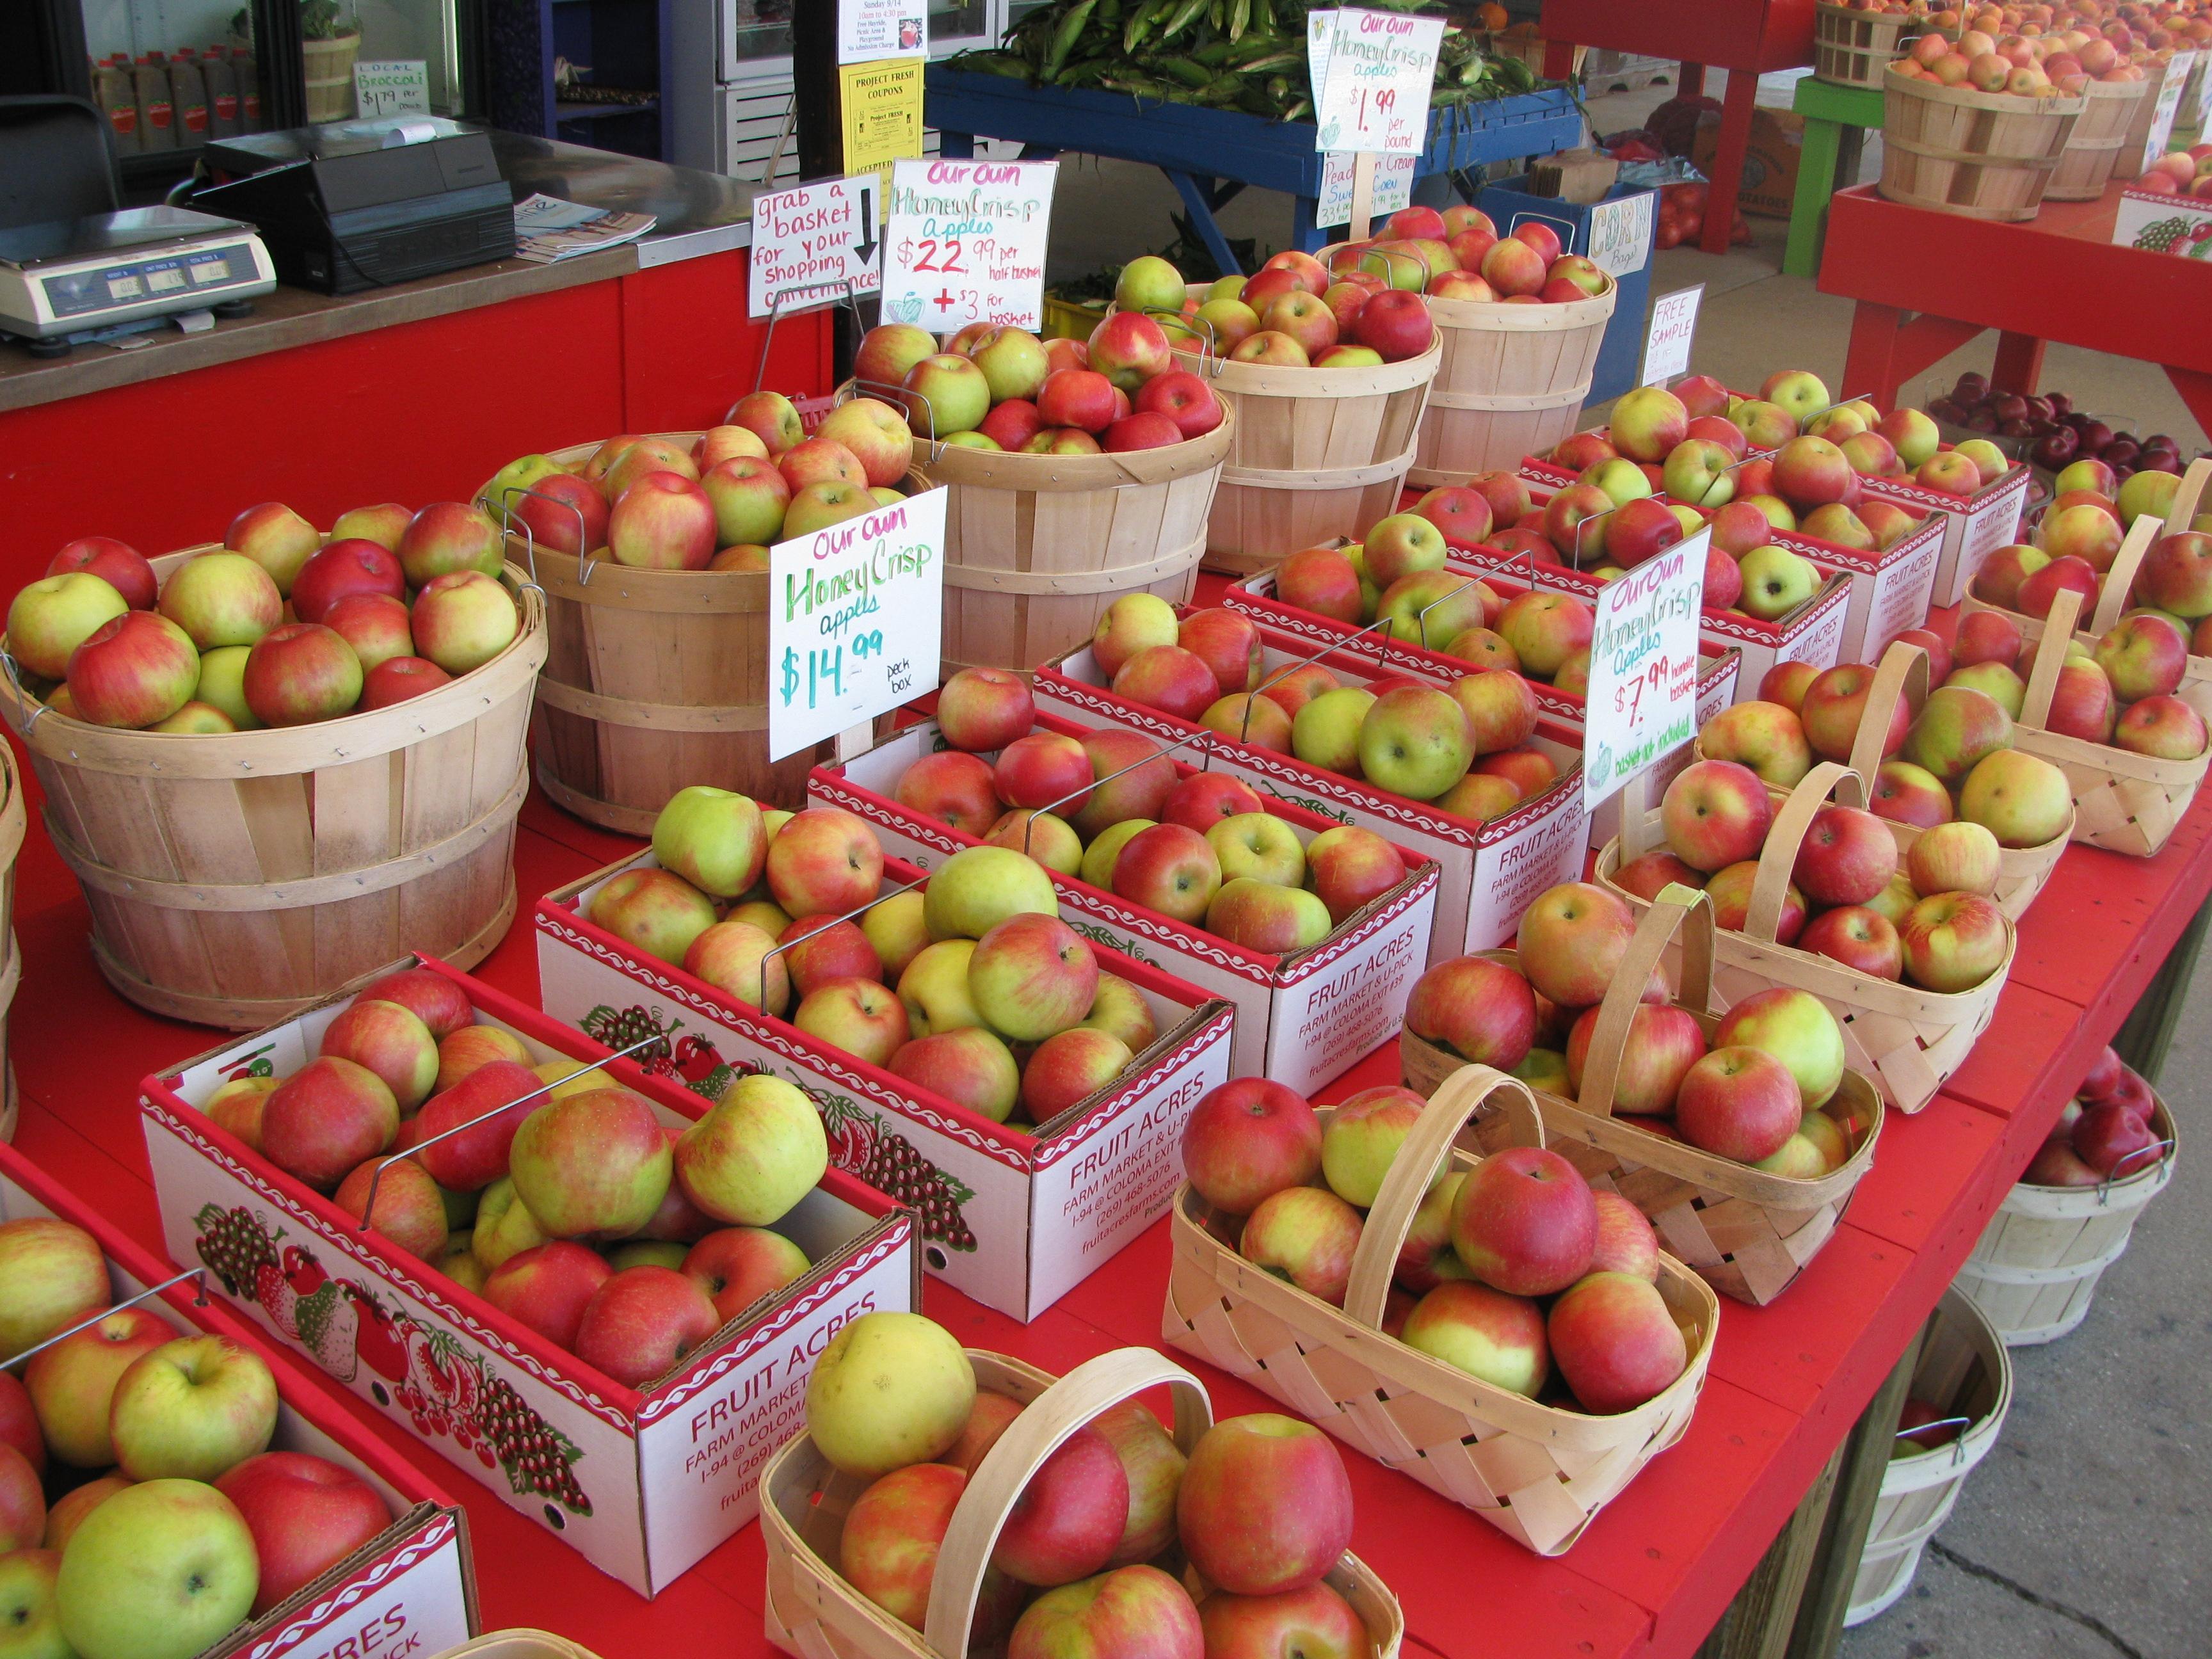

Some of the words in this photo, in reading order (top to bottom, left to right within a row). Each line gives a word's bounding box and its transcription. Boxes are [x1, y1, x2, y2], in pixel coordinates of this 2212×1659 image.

[864, 1, 885, 9] Sunday
[897, 10, 906, 19] pm
[1361, 13, 1385, 33] Our
[1386, 17, 1414, 36] Own
[856, 74, 888, 88] PROJECT
[891, 70, 914, 82] FRESH
[868, 86, 903, 99] COUPONS
[1384, 132, 1413, 151] pound
[1388, 118, 1405, 134] per
[856, 160, 893, 175] ACCEPTED
[927, 161, 970, 184] Our
[1386, 154, 1415, 172] Cream
[758, 190, 810, 228] grab
[830, 184, 845, 197] a
[1327, 185, 1352, 204] Swe
[775, 200, 852, 238] basket
[1591, 195, 1651, 258] CORN
[753, 246, 785, 266] for
[802, 231, 852, 259] your
[999, 246, 1019, 266] per
[765, 255, 845, 284] shopping
[989, 267, 1010, 280] half
[1011, 266, 1041, 281] bushel
[959, 290, 979, 320] $3
[1654, 297, 1688, 328] FREE
[1650, 319, 1691, 349] SAMPLE
[813, 527, 856, 560] Our
[786, 539, 933, 623] HoneyCrisp
[1611, 571, 1650, 613] Our
[1647, 553, 1684, 593] Own
[1884, 565, 1909, 592] FRUIT
[1908, 549, 1934, 575] ACRES
[820, 594, 881, 639] apples
[1789, 636, 1813, 661] FRUIT
[1812, 615, 1838, 648] ACRES
[887, 658, 910, 682] peck
[891, 674, 912, 694] box
[1670, 674, 1696, 702] basket
[1697, 694, 1724, 725] CRES
[1615, 745, 1641, 778] basket
[1658, 713, 1690, 753] included
[1499, 828, 1546, 871] FRUIT
[1491, 869, 1517, 893] FARM
[1519, 845, 1553, 876] MARKET
[1519, 863, 1550, 888] COLOMA
[1307, 963, 1361, 1014] FRUIT
[1363, 925, 1415, 979] ACRES
[1299, 1010, 1329, 1039] FARM
[1331, 982, 1372, 1018] MARKET
[1374, 975, 1381, 988] &
[1384, 950, 1414, 981] U-PICK
[1304, 1034, 1321, 1050] I-94
[1323, 1027, 1332, 1039] @
[1333, 1002, 1370, 1032] COLOMA
[1372, 986, 1388, 1004] EXIT
[1390, 974, 1404, 991] #39
[1309, 1016, 1389, 1078] fruitacresfarms.com
[1322, 1031, 1345, 1055] (269)
[1346, 1004, 1383, 1037] 468-5076
[1356, 1032, 1383, 1055] Produce
[1070, 1123, 1135, 1189] FRUIT
[1137, 1070, 1205, 1139] ACRES
[1063, 1180, 1098, 1217] FARM
[1102, 1138, 1153, 1188] MARKET
[1155, 1130, 1165, 1145] &
[1167, 1109, 1192, 1137] U-PI
[1072, 1205, 1093, 1227] I-94
[1094, 1196, 1105, 1211] @
[1106, 1161, 1151, 1200] COLOMA
[1155, 1138, 1176, 1164] EXIT
[1096, 1199, 1122, 1228] (269)
[1124, 1163, 1171, 1203] 468-5076
[1082, 1171, 1180, 1254] fruitacresfarms.com
[691, 1358, 779, 1444] FRUIT
[685, 1426, 735, 1474] FARM
[740, 1371, 810, 1435] MARKET
[701, 1455, 729, 1484] I-94
[733, 1444, 744, 1461] @
[748, 1395, 806, 1448] COLOMA
[737, 1445, 772, 1479] (269)
[776, 1422, 806, 1448] 468-
[317, 1603, 406, 1659] RES
